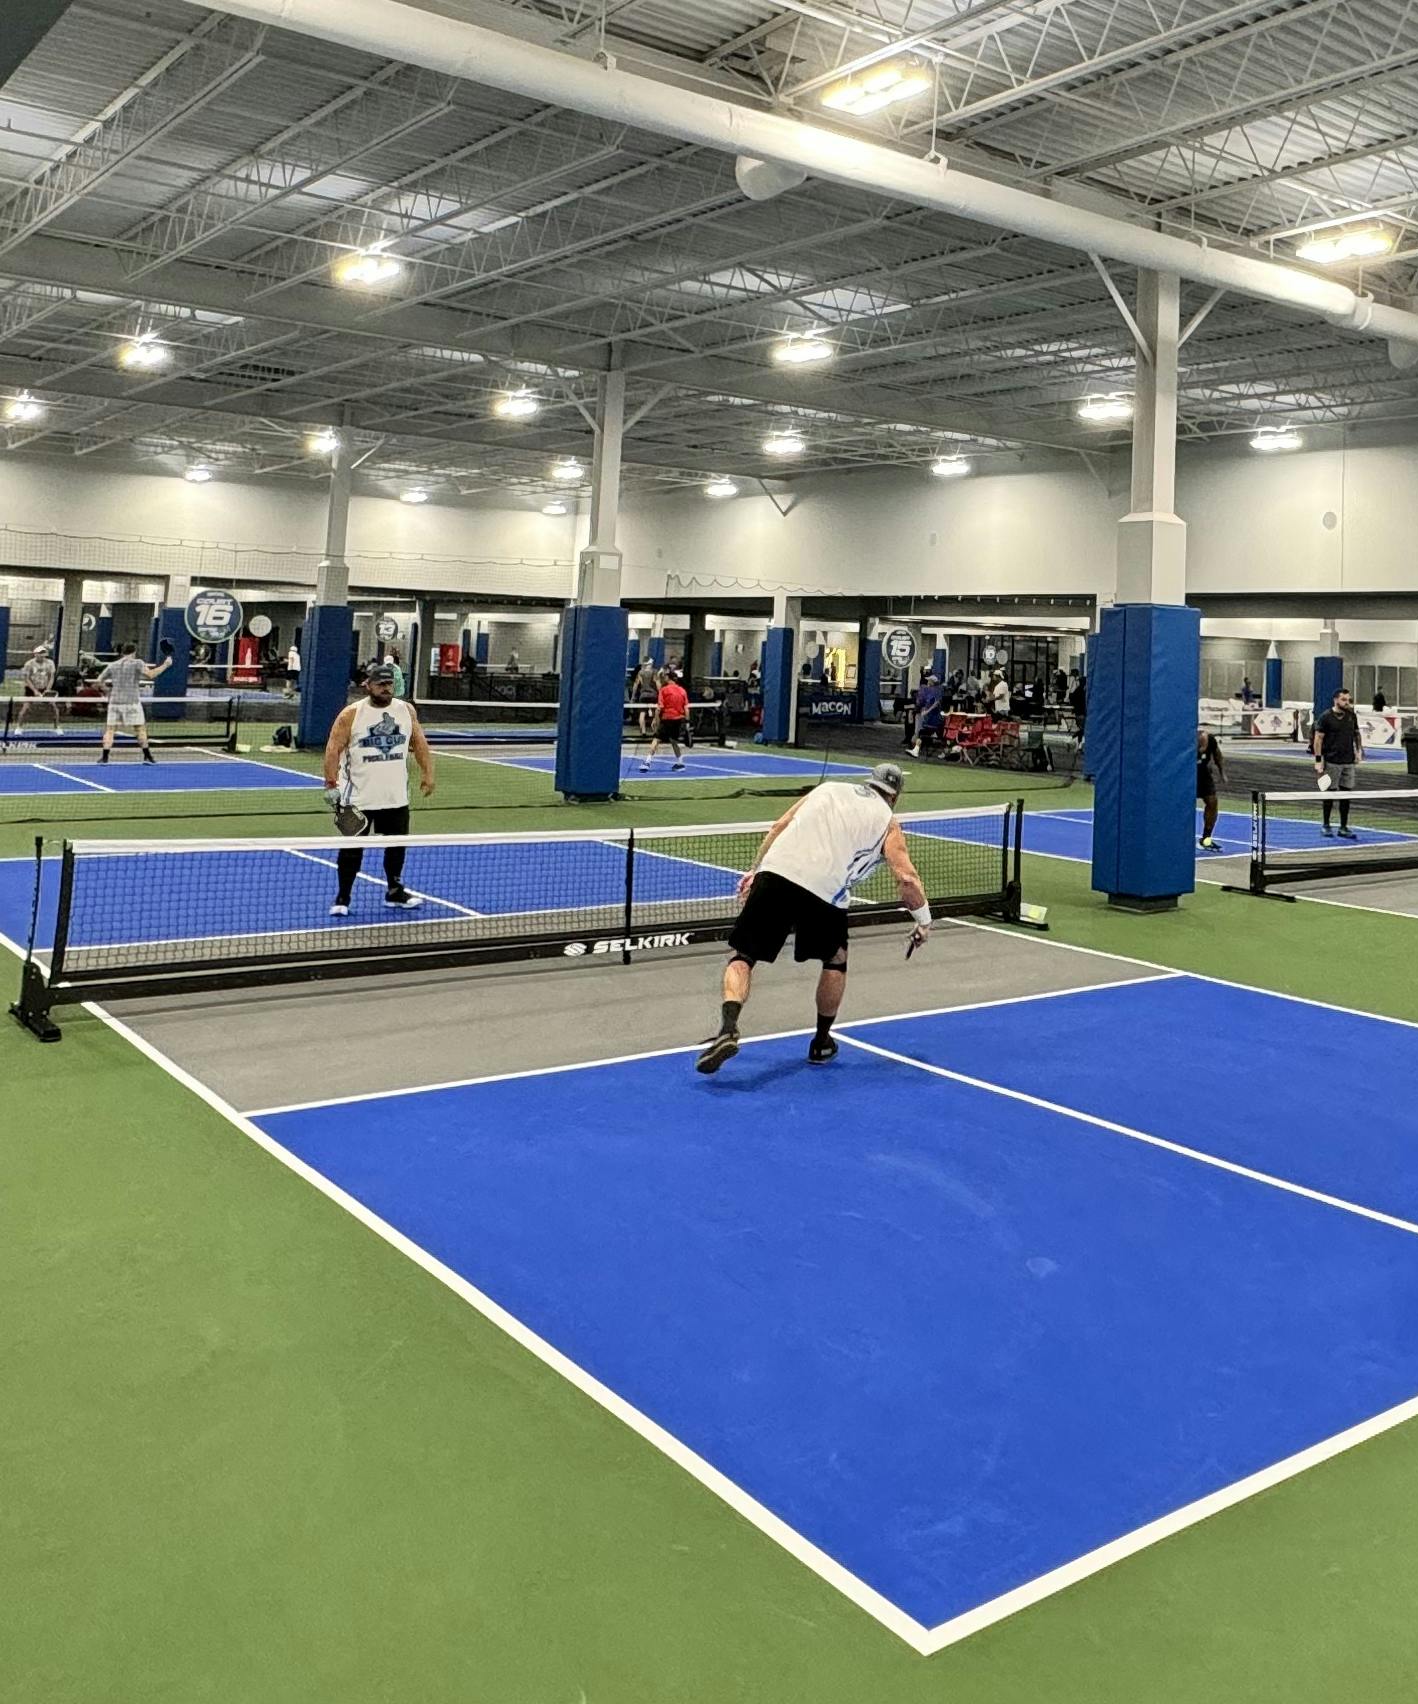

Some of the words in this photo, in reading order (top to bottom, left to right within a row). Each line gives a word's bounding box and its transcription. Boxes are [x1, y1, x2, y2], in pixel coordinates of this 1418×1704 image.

[195, 604, 234, 626] 16
[378, 623, 396, 635] 13
[890, 640, 912, 657] 15
[592, 932, 691, 954] SELKIRK
